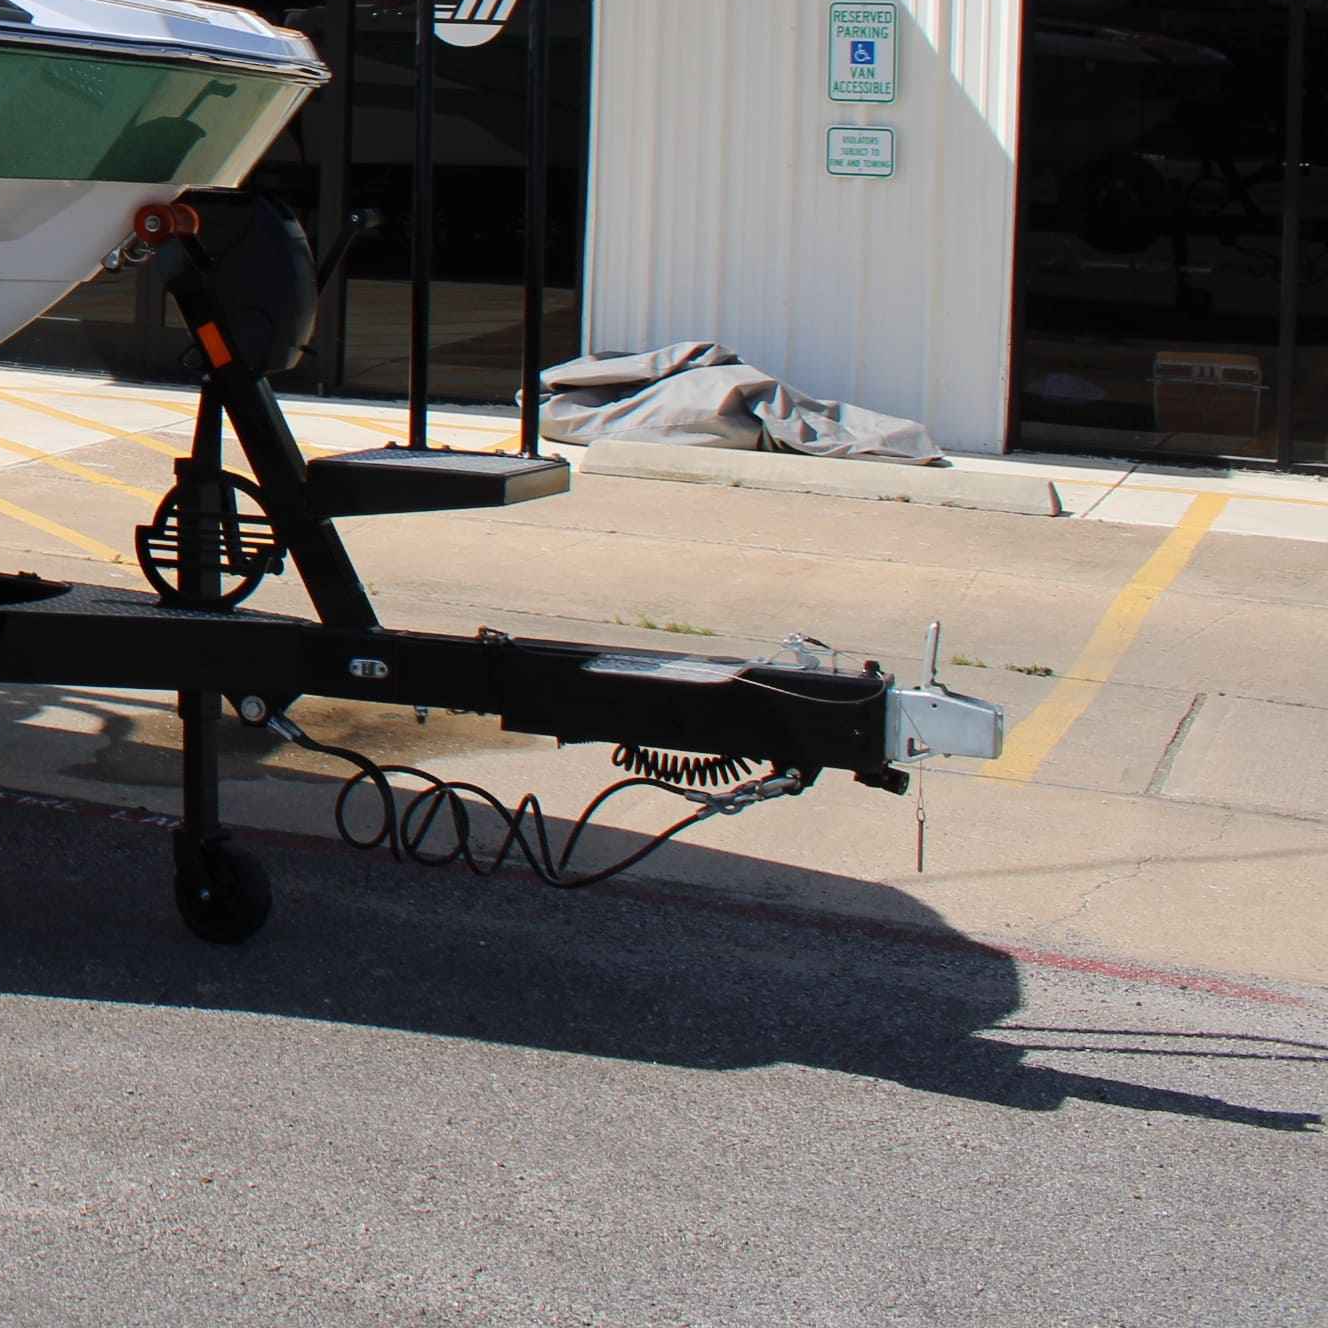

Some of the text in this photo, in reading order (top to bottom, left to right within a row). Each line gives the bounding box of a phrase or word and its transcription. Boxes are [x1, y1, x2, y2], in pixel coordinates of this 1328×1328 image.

[832, 10, 892, 23] RESERVED
[836, 25, 889, 39] PARKING
[850, 67, 875, 79] VAN
[832, 81, 891, 94] ACCESSIBLE
